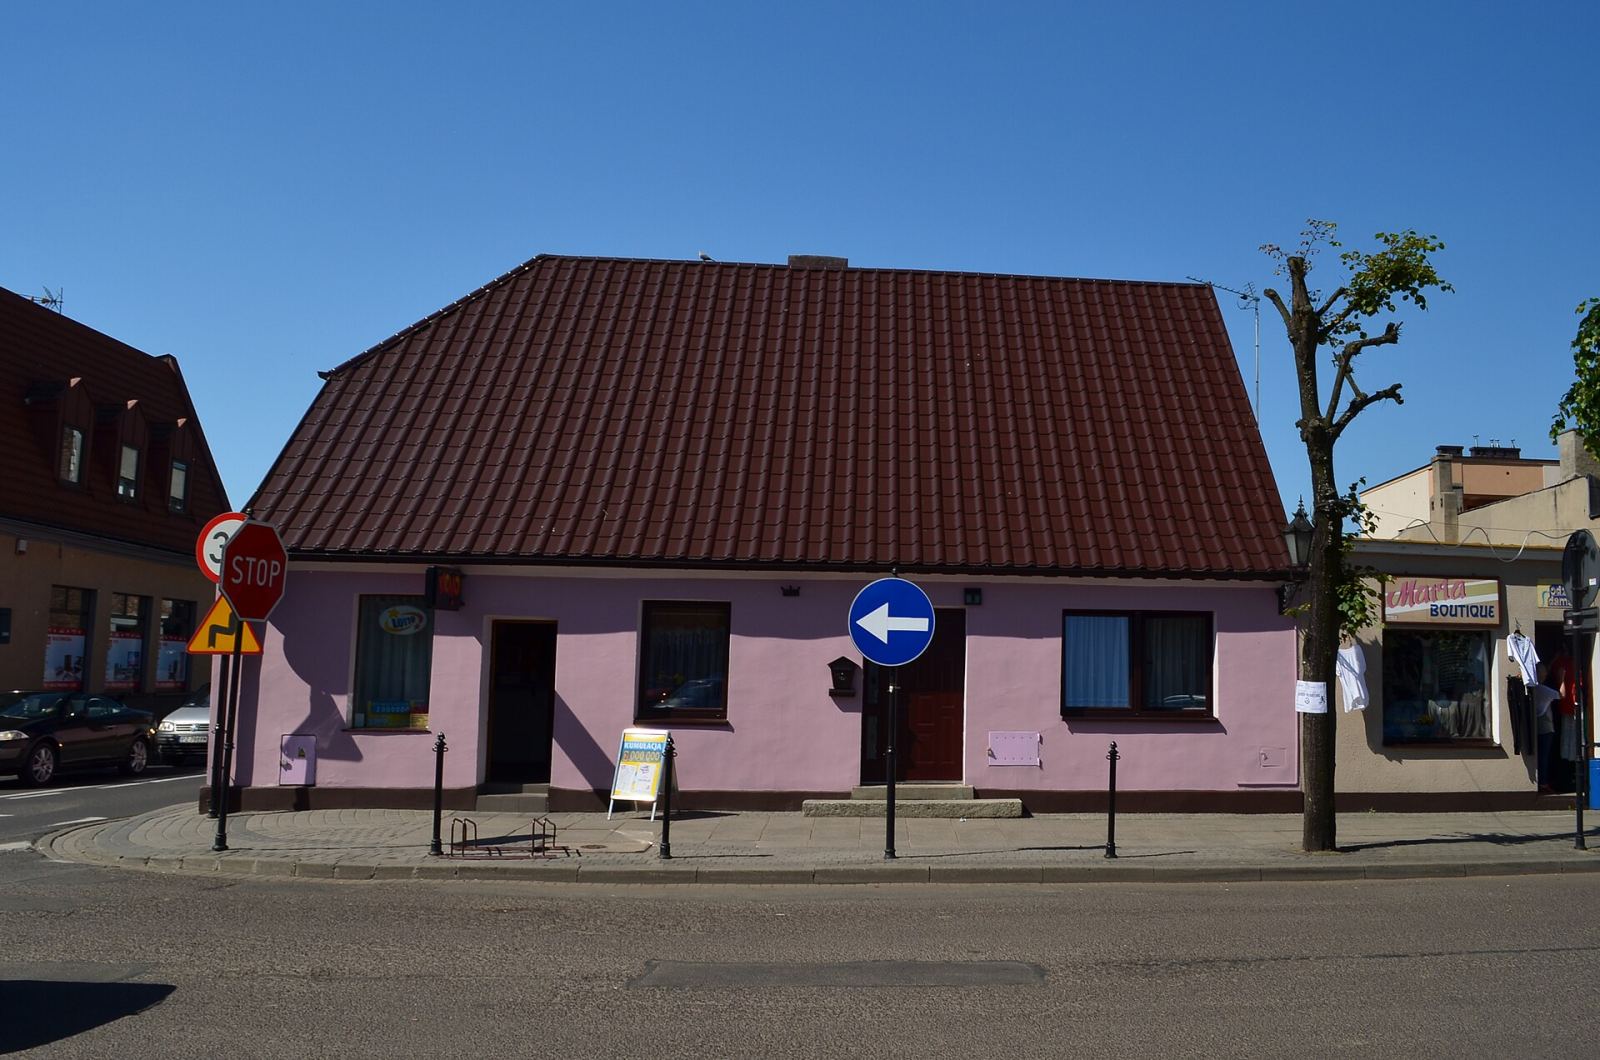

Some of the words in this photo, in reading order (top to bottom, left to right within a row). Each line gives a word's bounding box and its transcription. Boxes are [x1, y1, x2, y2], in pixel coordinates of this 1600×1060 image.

[210, 531, 229, 564] 3
[231, 555, 281, 588] STOP
[1387, 579, 1467, 608] Marta
[1430, 604, 1495, 618] BOUTIQUE
[624, 741, 662, 751] KUMULACJA
